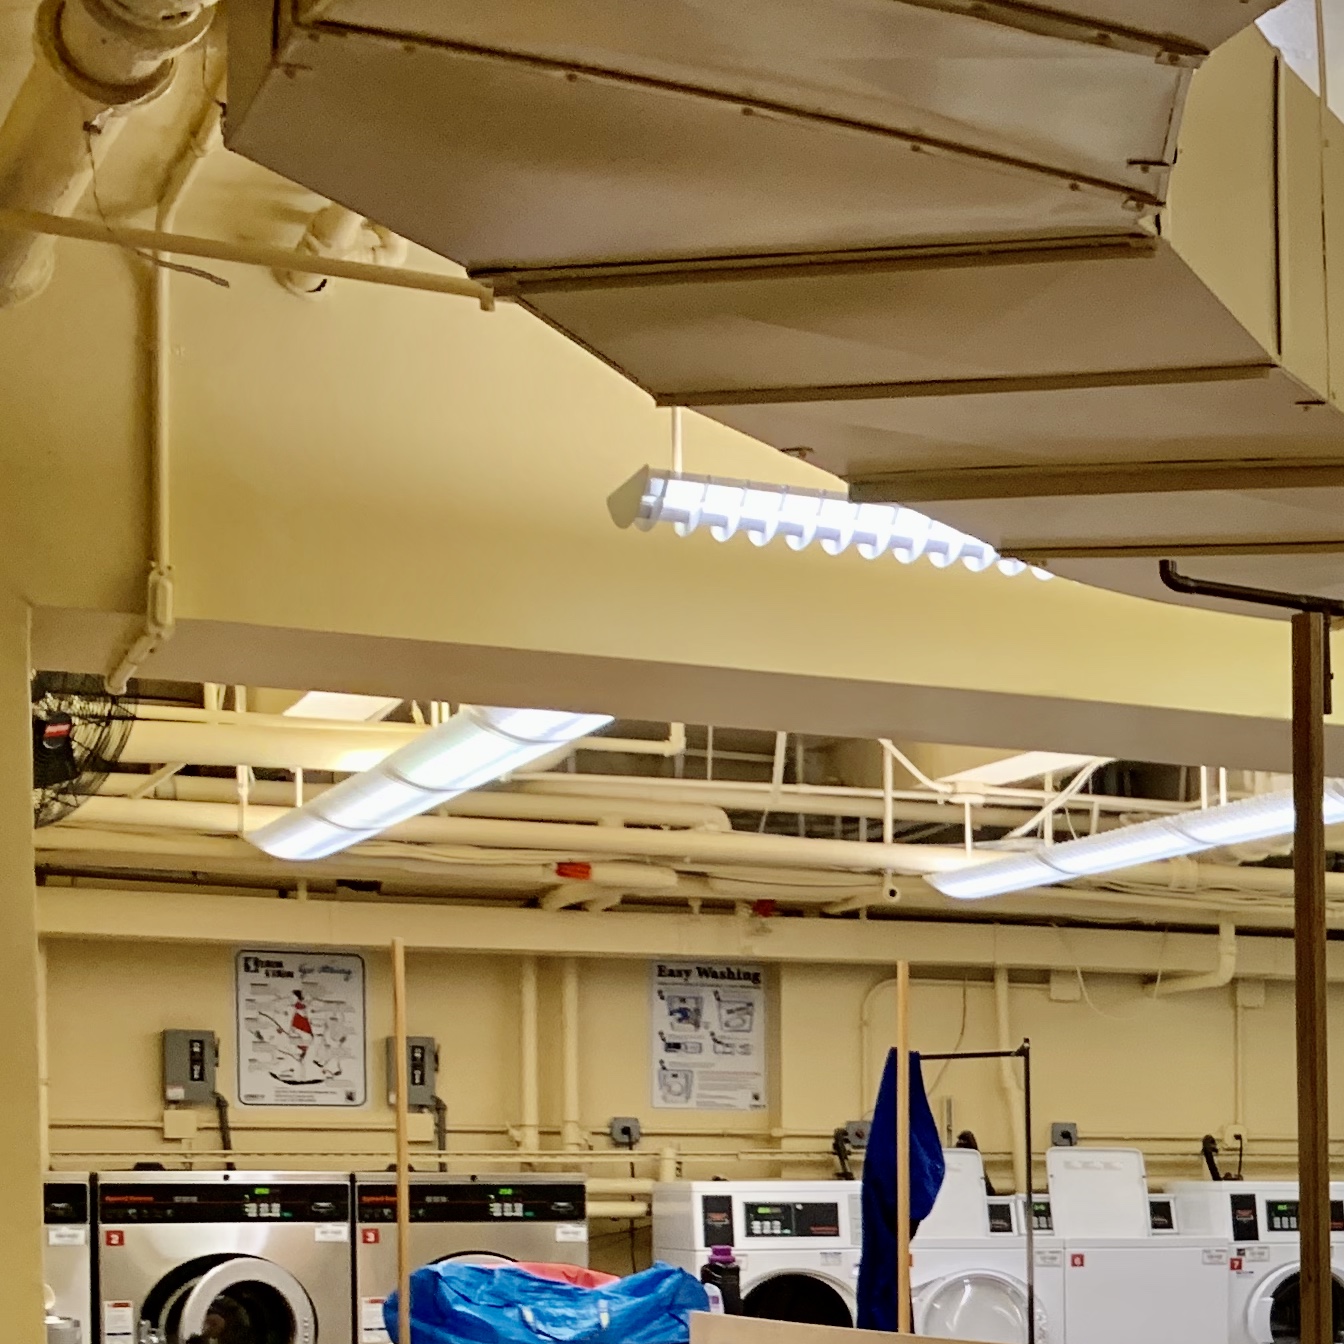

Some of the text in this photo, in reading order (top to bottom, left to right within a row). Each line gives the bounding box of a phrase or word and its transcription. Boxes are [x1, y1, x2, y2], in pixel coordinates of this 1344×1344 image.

[657, 965, 761, 984] Easy Washing
[109, 1233, 120, 1244] 2
[366, 1232, 376, 1242] 3
[1232, 1260, 1240, 1269] 7
